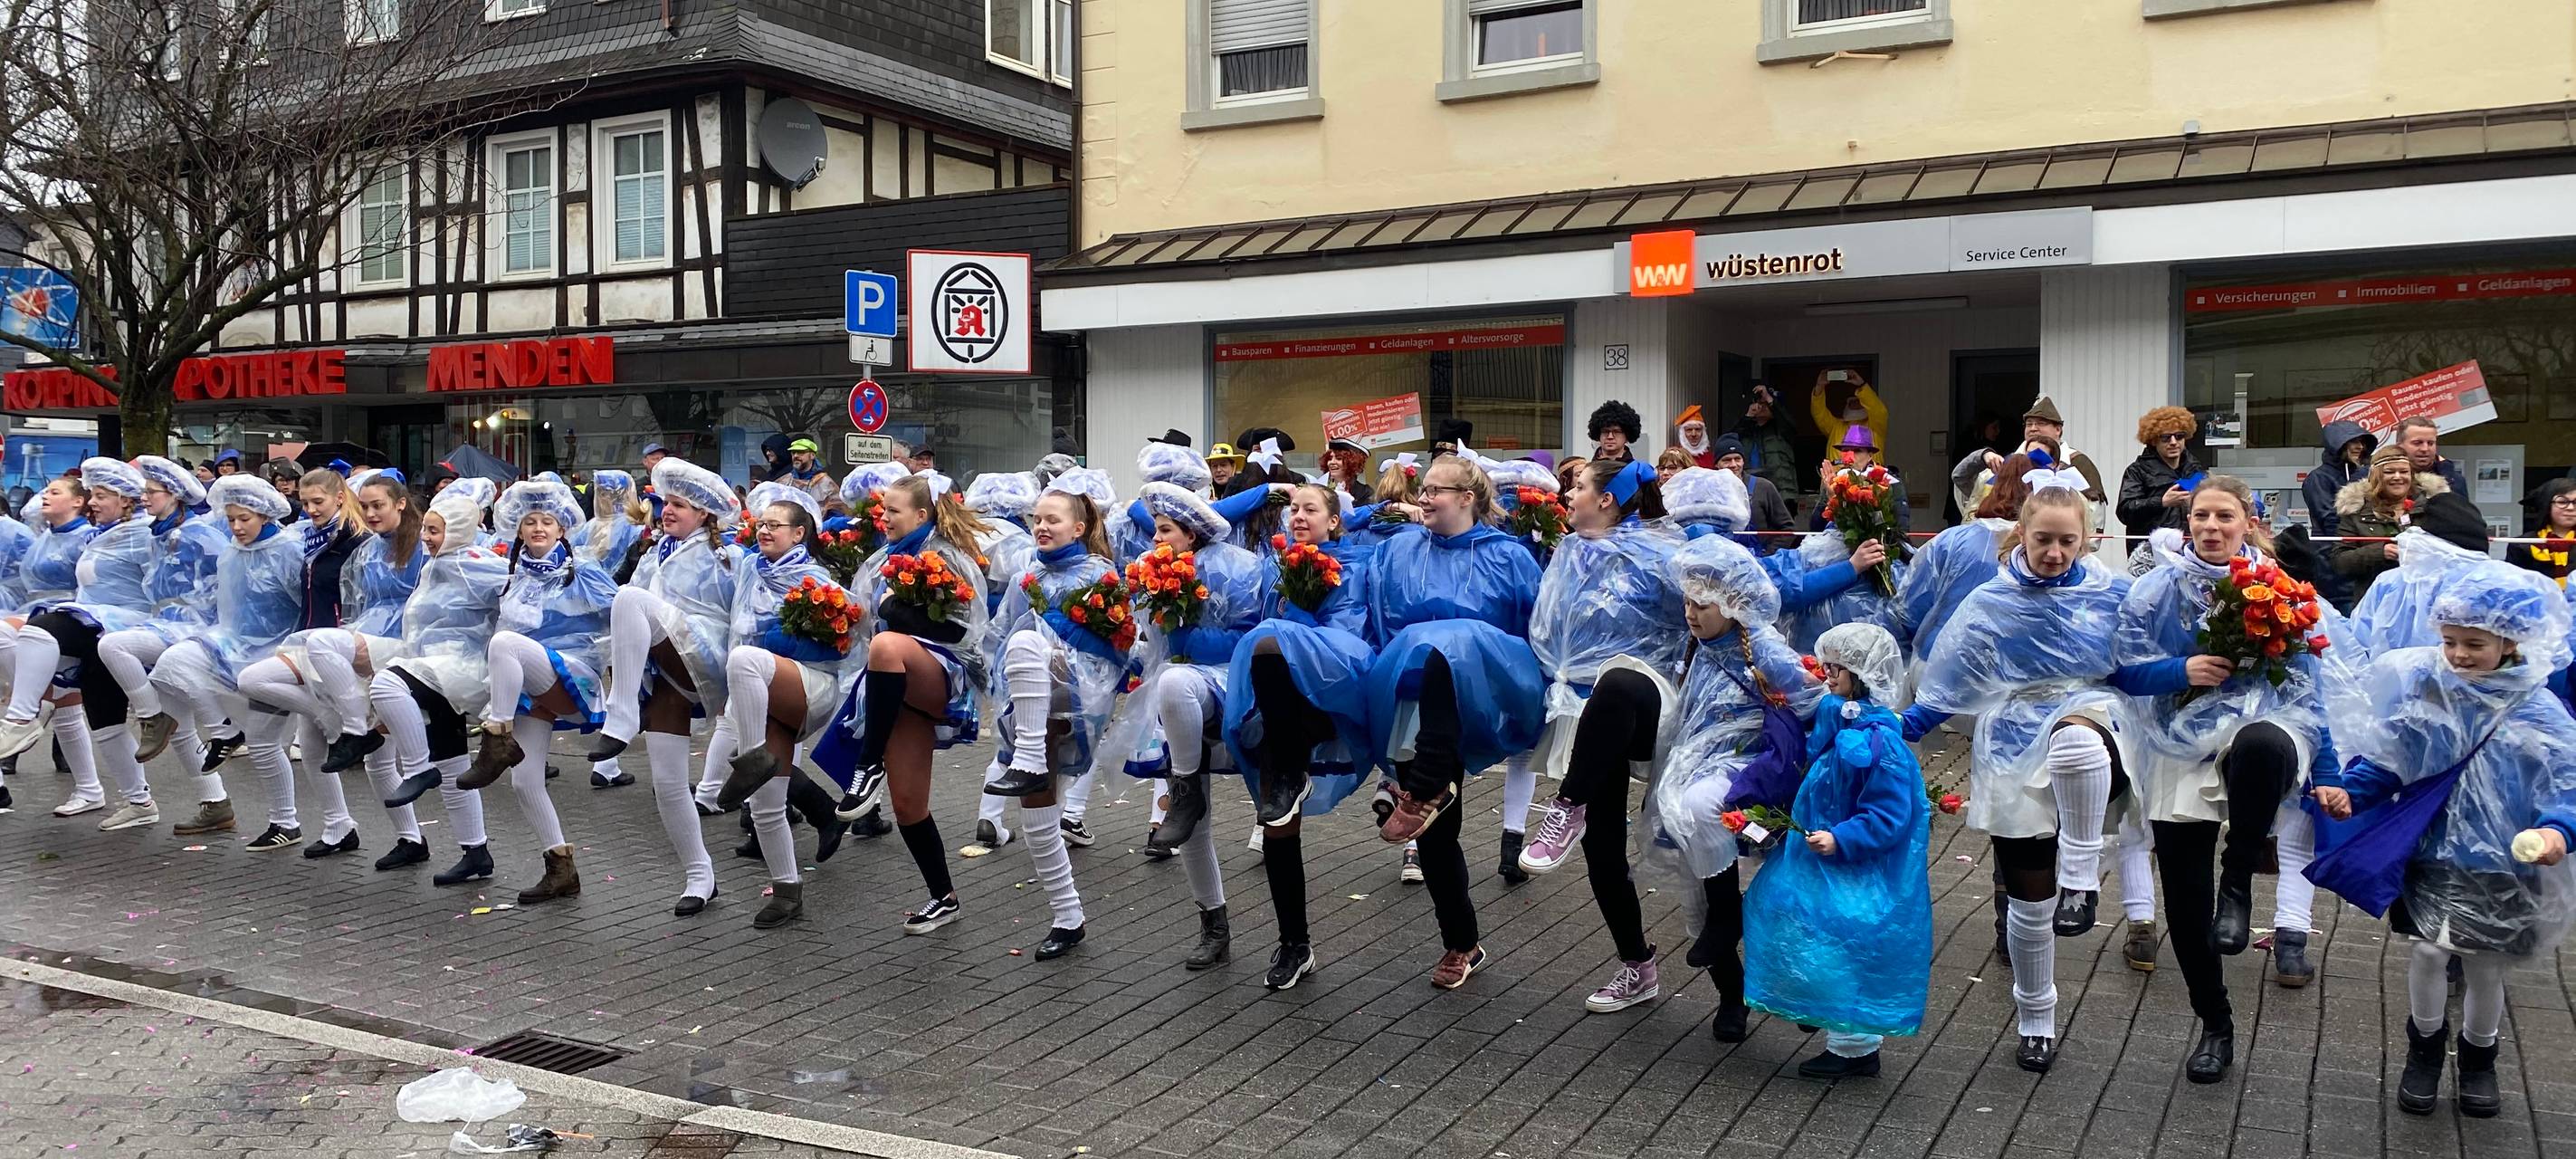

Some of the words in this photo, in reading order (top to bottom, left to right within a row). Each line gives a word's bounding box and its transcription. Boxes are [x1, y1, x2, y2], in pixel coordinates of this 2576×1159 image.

[1706, 247, 1843, 279] wüstenrot
[1966, 248, 2016, 263] Service
[2019, 245, 2067, 259] Center
[2215, 290, 2316, 304] Versicherungen
[2356, 284, 2437, 298] Immobilien
[2477, 275, 2571, 292] Geldanlagen
[858, 280, 885, 326] P
[1232, 347, 1273, 359] Bausparen
[1294, 342, 1357, 354] Finanzierungen
[1380, 337, 1434, 350] Geldanlagen
[1461, 332, 1524, 344] Altersvorsorge
[1607, 348, 1627, 367] 38
[426, 336, 614, 392] MENDEN
[2390, 383, 2423, 397] Bauen,
[2421, 372, 2454, 387] kaufen
[2454, 366, 2475, 377] oder
[2395, 381, 2457, 405] modernisieren
[2398, 402, 2419, 416] jetzt
[850, 449, 889, 460] Seitenstreifen
[857, 440, 867, 448] auf
[869, 439, 883, 449] dem
